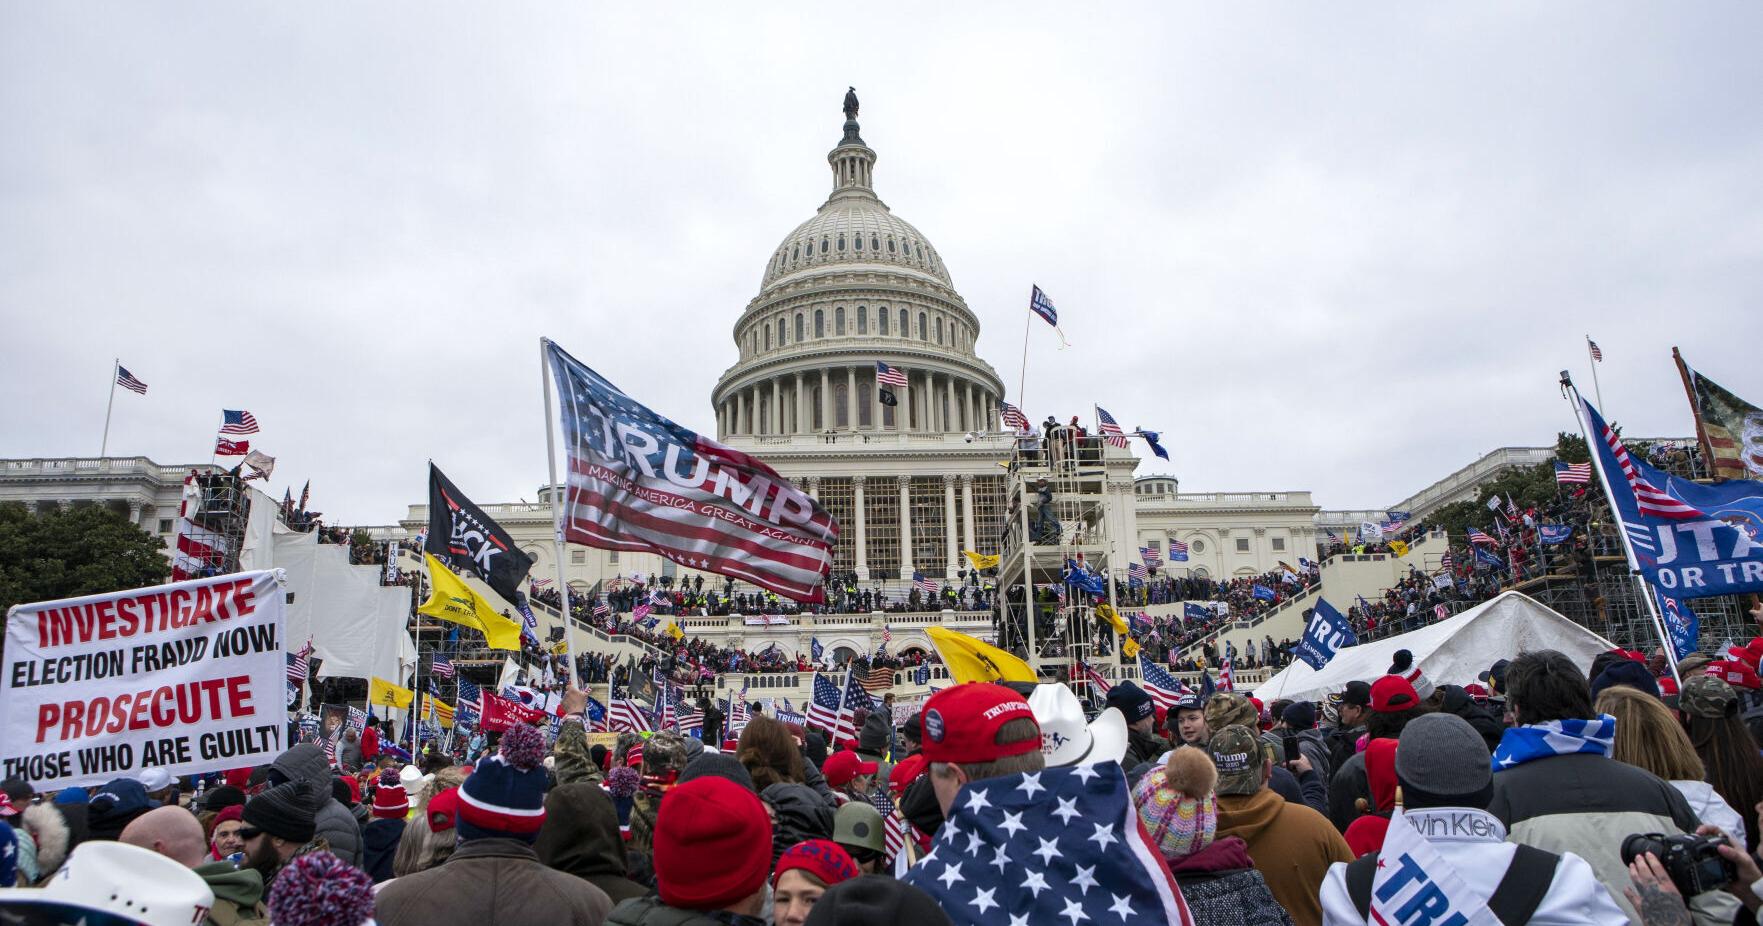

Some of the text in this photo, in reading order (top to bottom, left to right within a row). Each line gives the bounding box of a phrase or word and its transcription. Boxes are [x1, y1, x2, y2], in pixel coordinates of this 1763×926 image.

[589, 404, 812, 525] TRUMP
[447, 504, 503, 572] UCK
[588, 465, 816, 547] MAKING AMERICA GREAT AGAIN!
[1657, 560, 1763, 589] OR TR
[37, 578, 256, 648] INVESTIGATE
[1308, 611, 1346, 654] TRU
[11, 623, 279, 688] ELECTION FRAUD NOW.
[35, 675, 255, 743] PROSECUTE
[777, 713, 805, 726] TRUMP
[3, 724, 279, 782] THOSE WHO ARE GUILTY
[1213, 751, 1248, 764] Trump
[1451, 812, 1497, 837] Klein
[1375, 852, 1469, 926] TR
